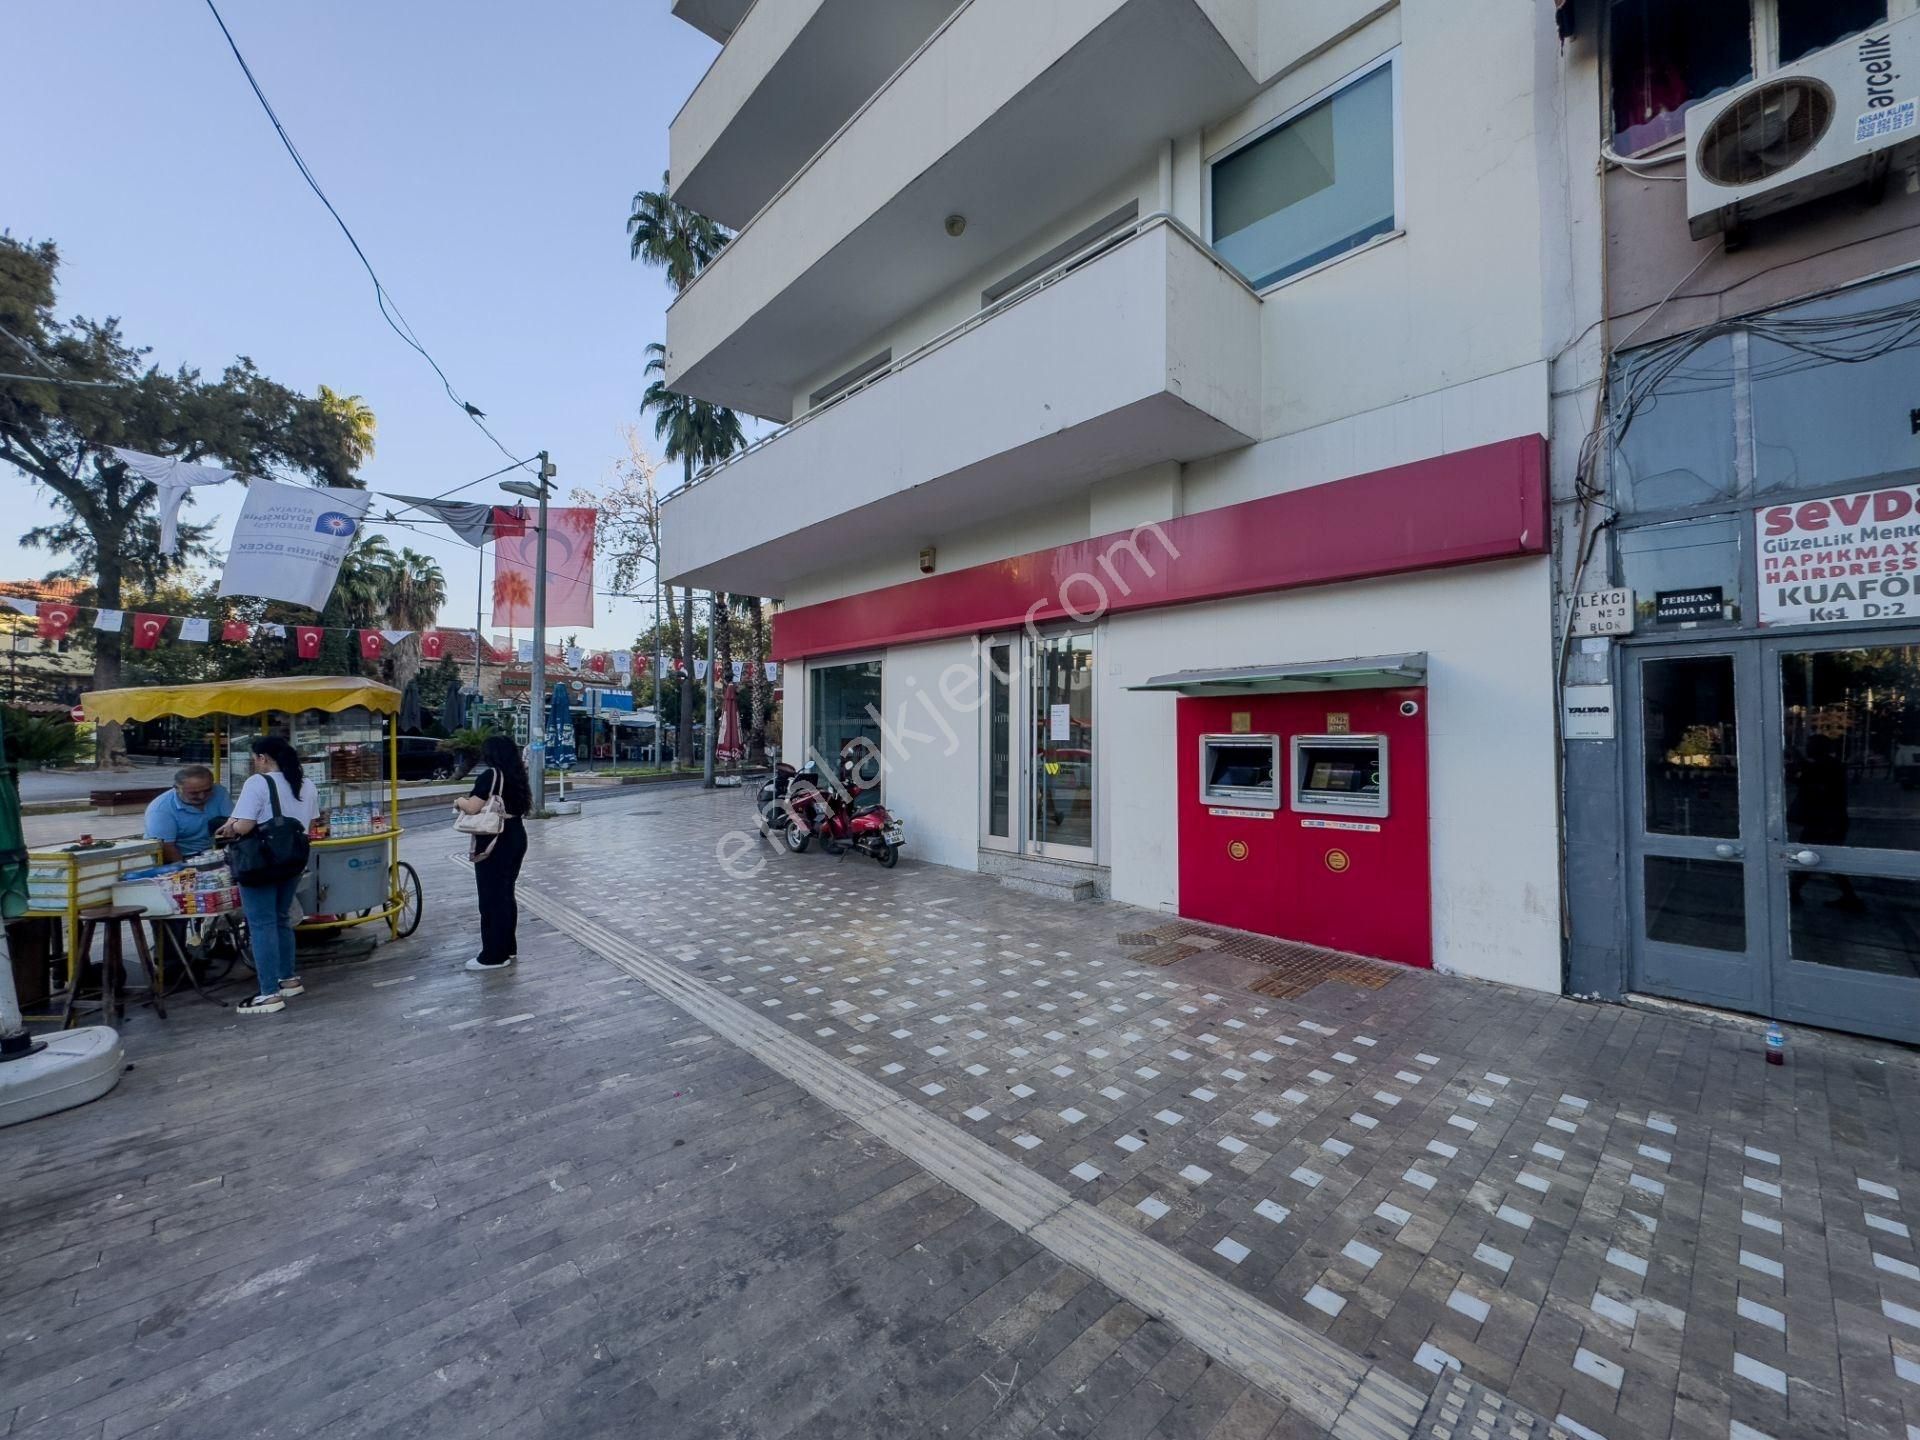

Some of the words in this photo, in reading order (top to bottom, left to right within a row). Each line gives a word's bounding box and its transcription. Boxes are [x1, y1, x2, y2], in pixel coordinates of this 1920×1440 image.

[1859, 34, 1901, 108] arçelik
[1766, 557, 1918, 584] HAIRDRESS
[1662, 593, 1712, 605] FERHAN
[1618, 607, 1625, 616] 3
[1658, 607, 1696, 616] MODA
[1699, 603, 1720, 613] EVİ
[1863, 603, 1906, 618] D:2
